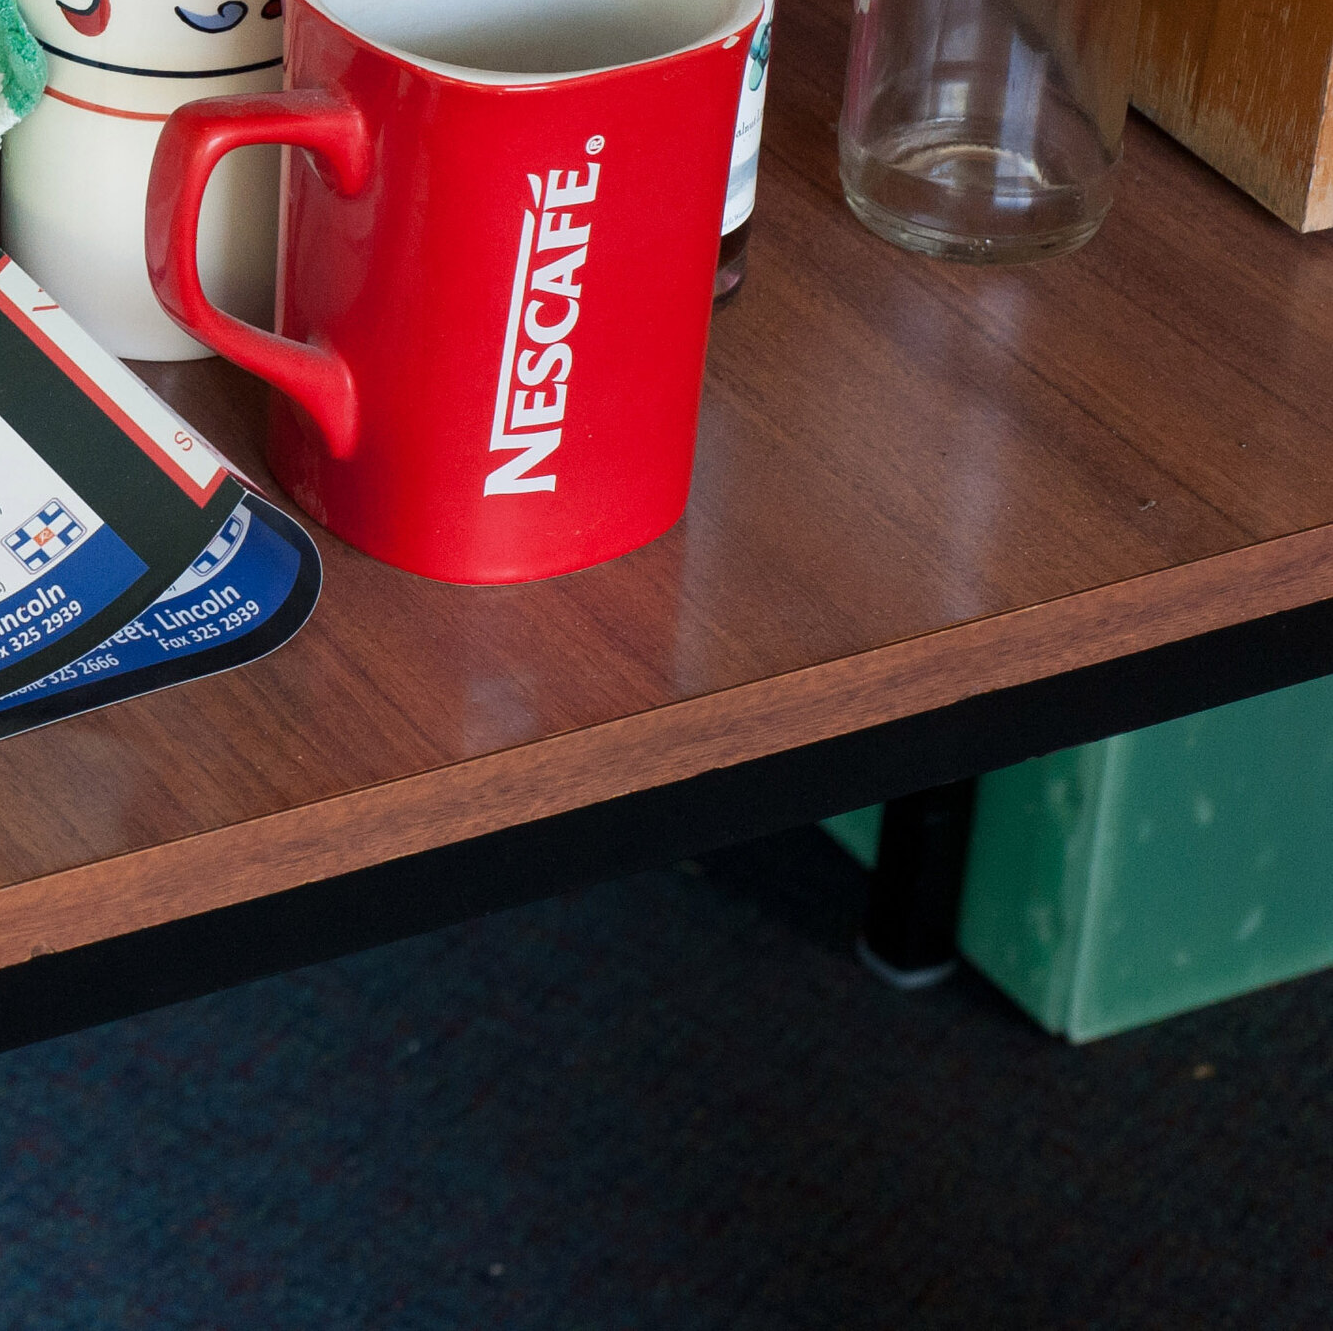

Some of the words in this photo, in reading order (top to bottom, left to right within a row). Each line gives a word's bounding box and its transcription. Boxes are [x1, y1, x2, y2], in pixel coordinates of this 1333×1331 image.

[483, 162, 602, 497] NESCAFÉ
[8, 628, 41, 652] 325
[42, 599, 83, 633] 2939
[79, 653, 120, 677] 2666
[157, 634, 189, 652] Fax
[191, 623, 222, 644] 325
[221, 599, 261, 632] 2939
[153, 584, 241, 631] Lincoln
